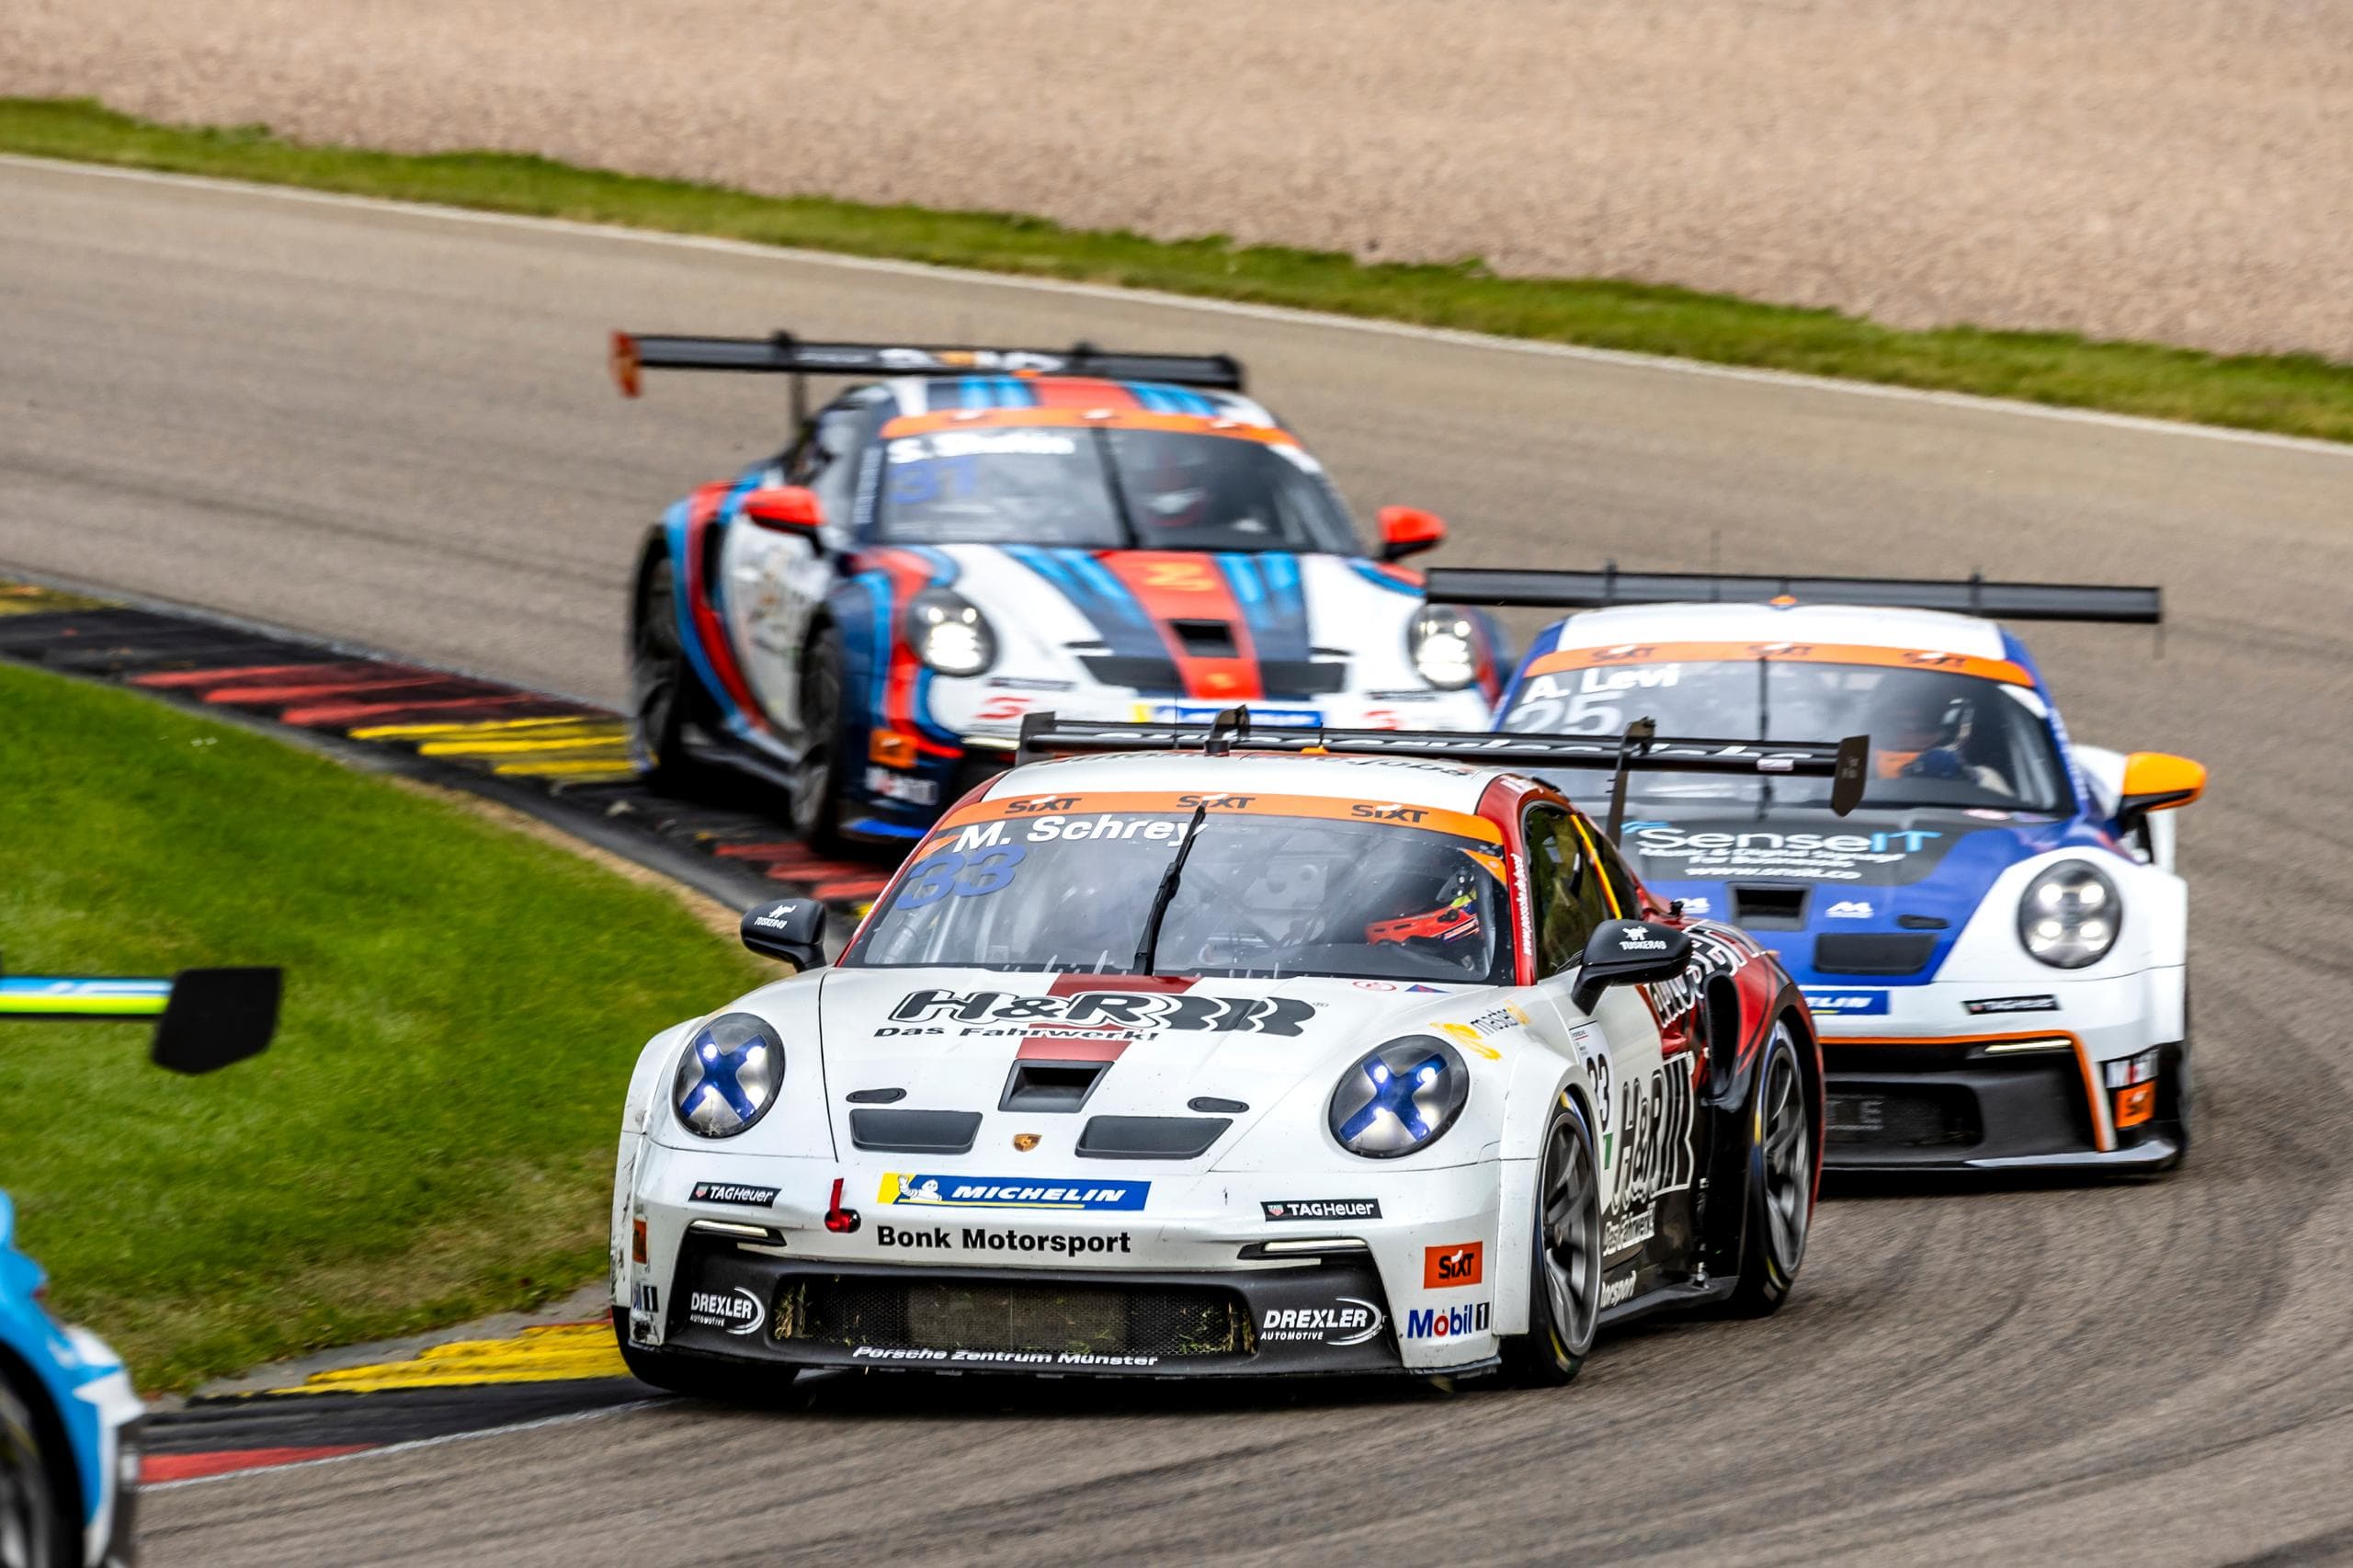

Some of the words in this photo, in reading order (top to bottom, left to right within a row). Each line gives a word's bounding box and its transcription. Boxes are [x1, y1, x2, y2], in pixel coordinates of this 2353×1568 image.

[1522, 671, 1570, 703] A.
[1580, 664, 1680, 694] Levi
[1506, 690, 1627, 734] 25
[953, 821, 1011, 853] M.
[1027, 814, 1209, 847] Schrey
[1636, 827, 1942, 853] SenseIT
[894, 844, 1027, 911] 33
[874, 1027, 945, 1039] Das
[959, 1027, 1158, 1042] Fahrwerk!
[951, 1186, 1126, 1202] MICHELIN
[877, 1225, 951, 1249] Bonk
[962, 1228, 1131, 1257] Motorsport
[690, 1291, 753, 1320] DREXLER
[1263, 1309, 1368, 1328] DREXLER
[689, 1313, 725, 1326] AUTOMOTIVE
[1407, 1303, 1472, 1338] Mobil
[1260, 1331, 1323, 1341] AUTOMOTIVE
[853, 1346, 947, 1360] Porsche
[950, 1349, 1052, 1363] Zentrum
[1057, 1351, 1158, 1367] Münster
